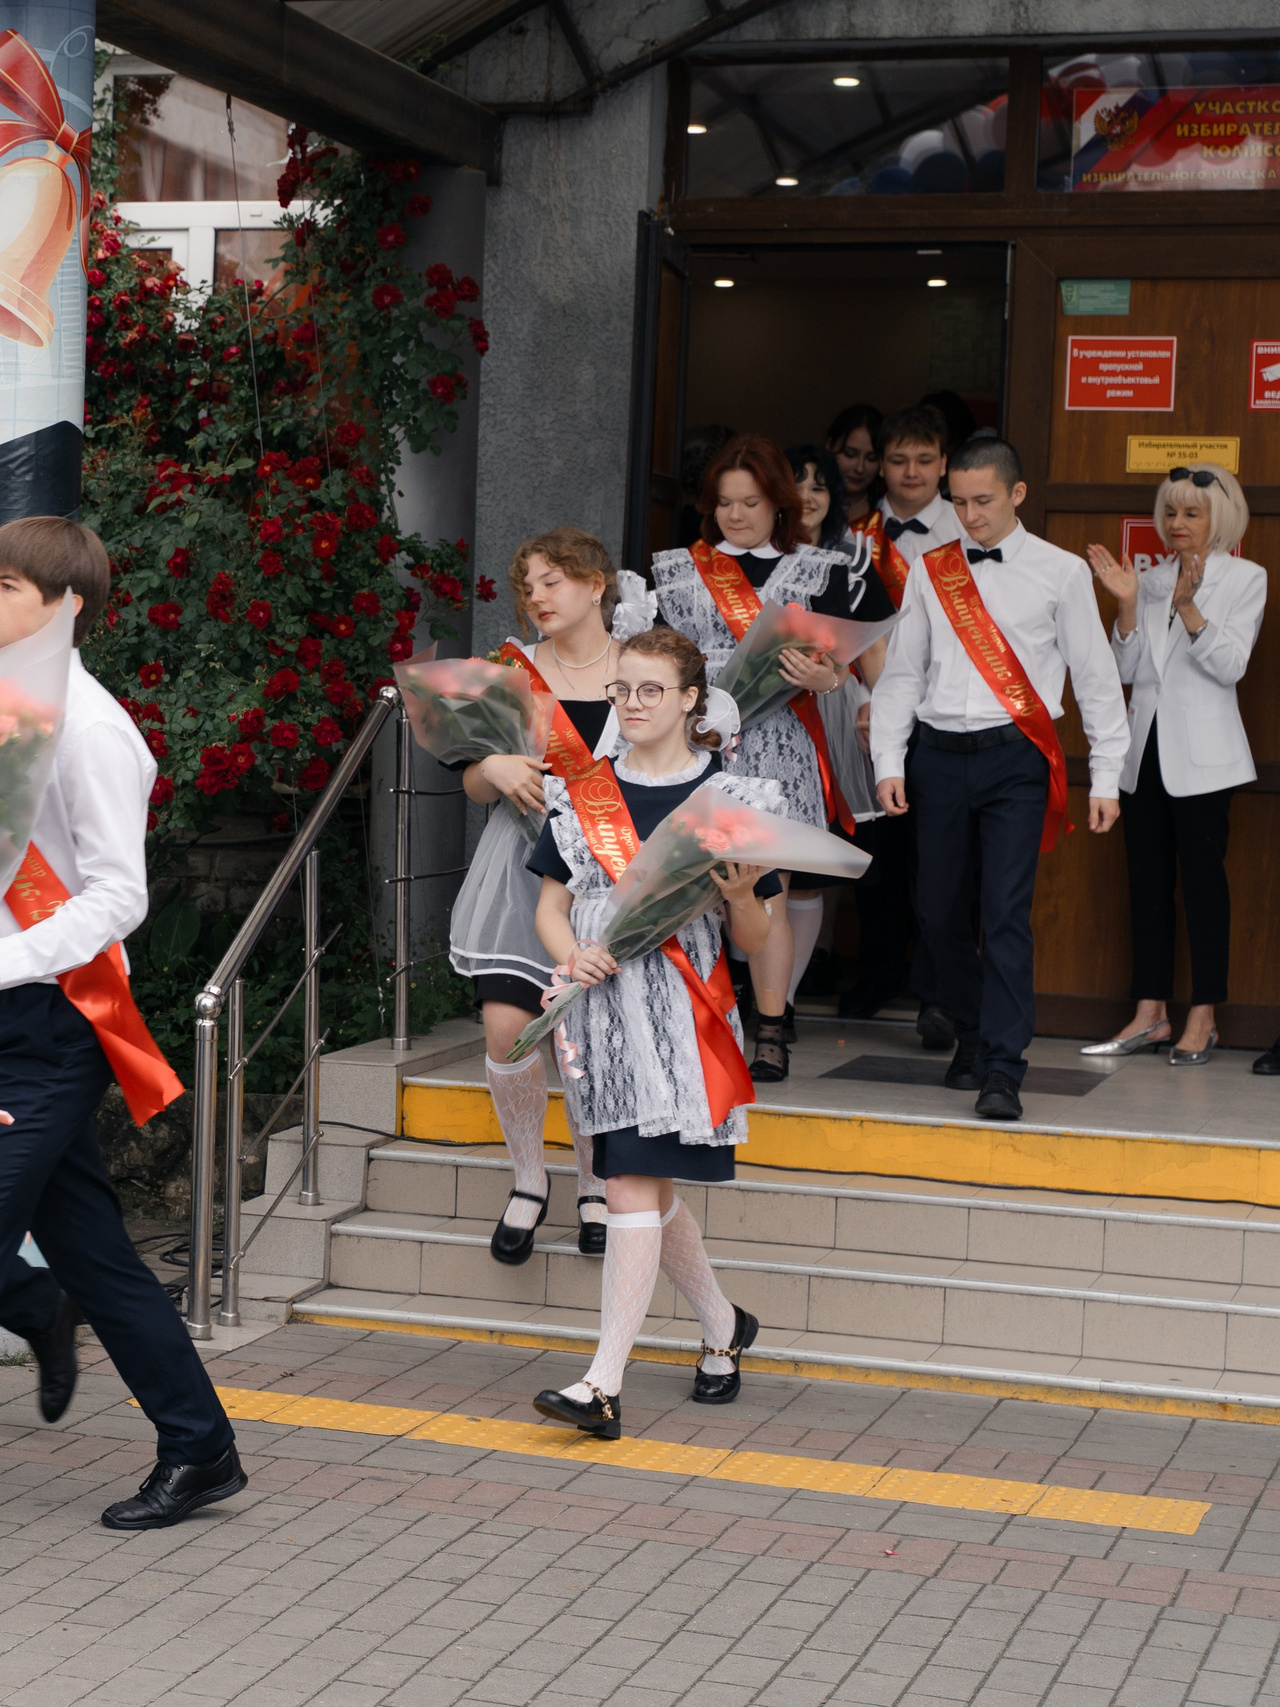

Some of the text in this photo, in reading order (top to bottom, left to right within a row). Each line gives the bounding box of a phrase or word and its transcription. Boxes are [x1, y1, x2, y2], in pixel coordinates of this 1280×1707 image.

[1082, 169, 1208, 183] ИЗБИРАТЕЛЬНОГО
[1079, 350, 1126, 359] учреждении
[1127, 350, 1171, 359] установлен
[1098, 361, 1143, 372] пропускной
[1106, 389, 1134, 398] режим
[1138, 442, 1228, 452] Избирательный участок
[935, 551, 1040, 717] Выпускник 2026
[579, 776, 627, 880] Выпуск
[621, 825, 637, 857] Дрот
